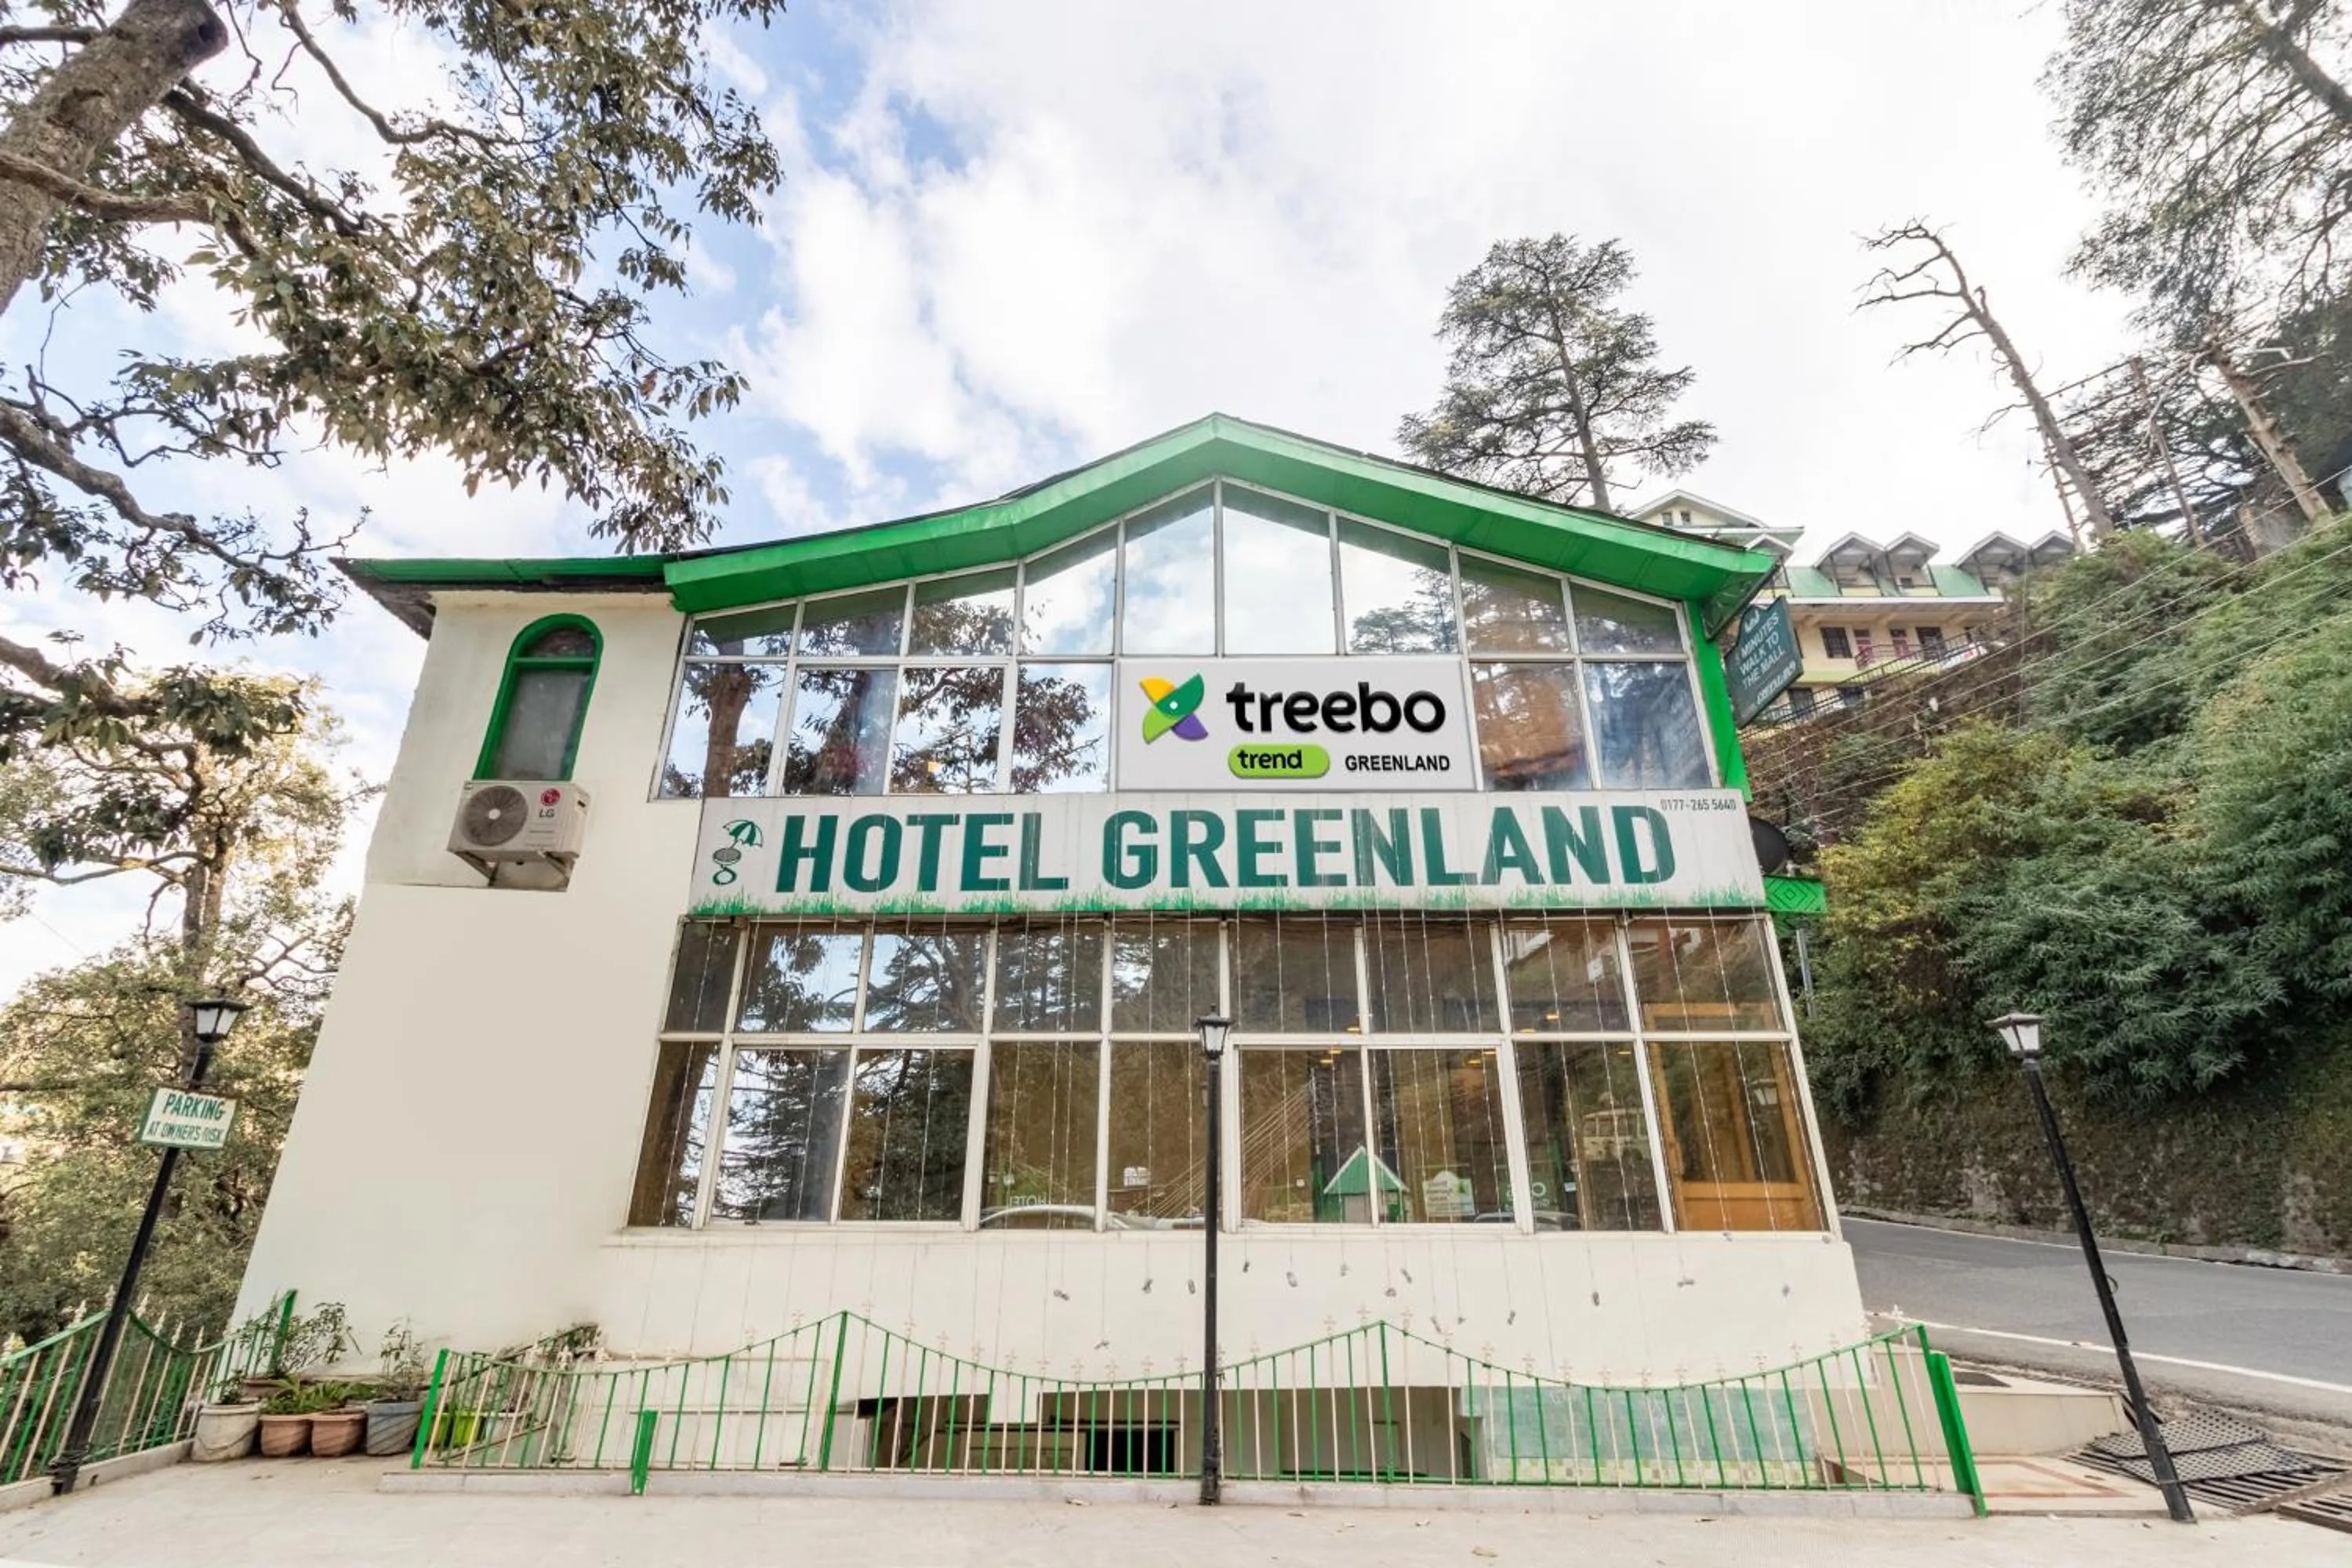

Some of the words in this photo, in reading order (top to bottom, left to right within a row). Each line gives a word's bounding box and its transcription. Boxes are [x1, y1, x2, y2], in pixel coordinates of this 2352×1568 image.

[1741, 611, 1780, 658] MINUTES
[1740, 648, 1766, 675] WALK
[1766, 633, 1780, 650] TO
[1742, 670, 1760, 690] THE
[1761, 648, 1785, 675] MALL
[1226, 681, 1446, 734] treebo
[1237, 749, 1303, 770] trend
[1345, 755, 1450, 772] GREENLAND
[539, 808, 554, 818] LG
[775, 812, 1069, 893] HOTEL
[1102, 806, 1676, 891] GREENLAND
[163, 1093, 226, 1120] PARKING
[147, 1121, 161, 1137] AT
